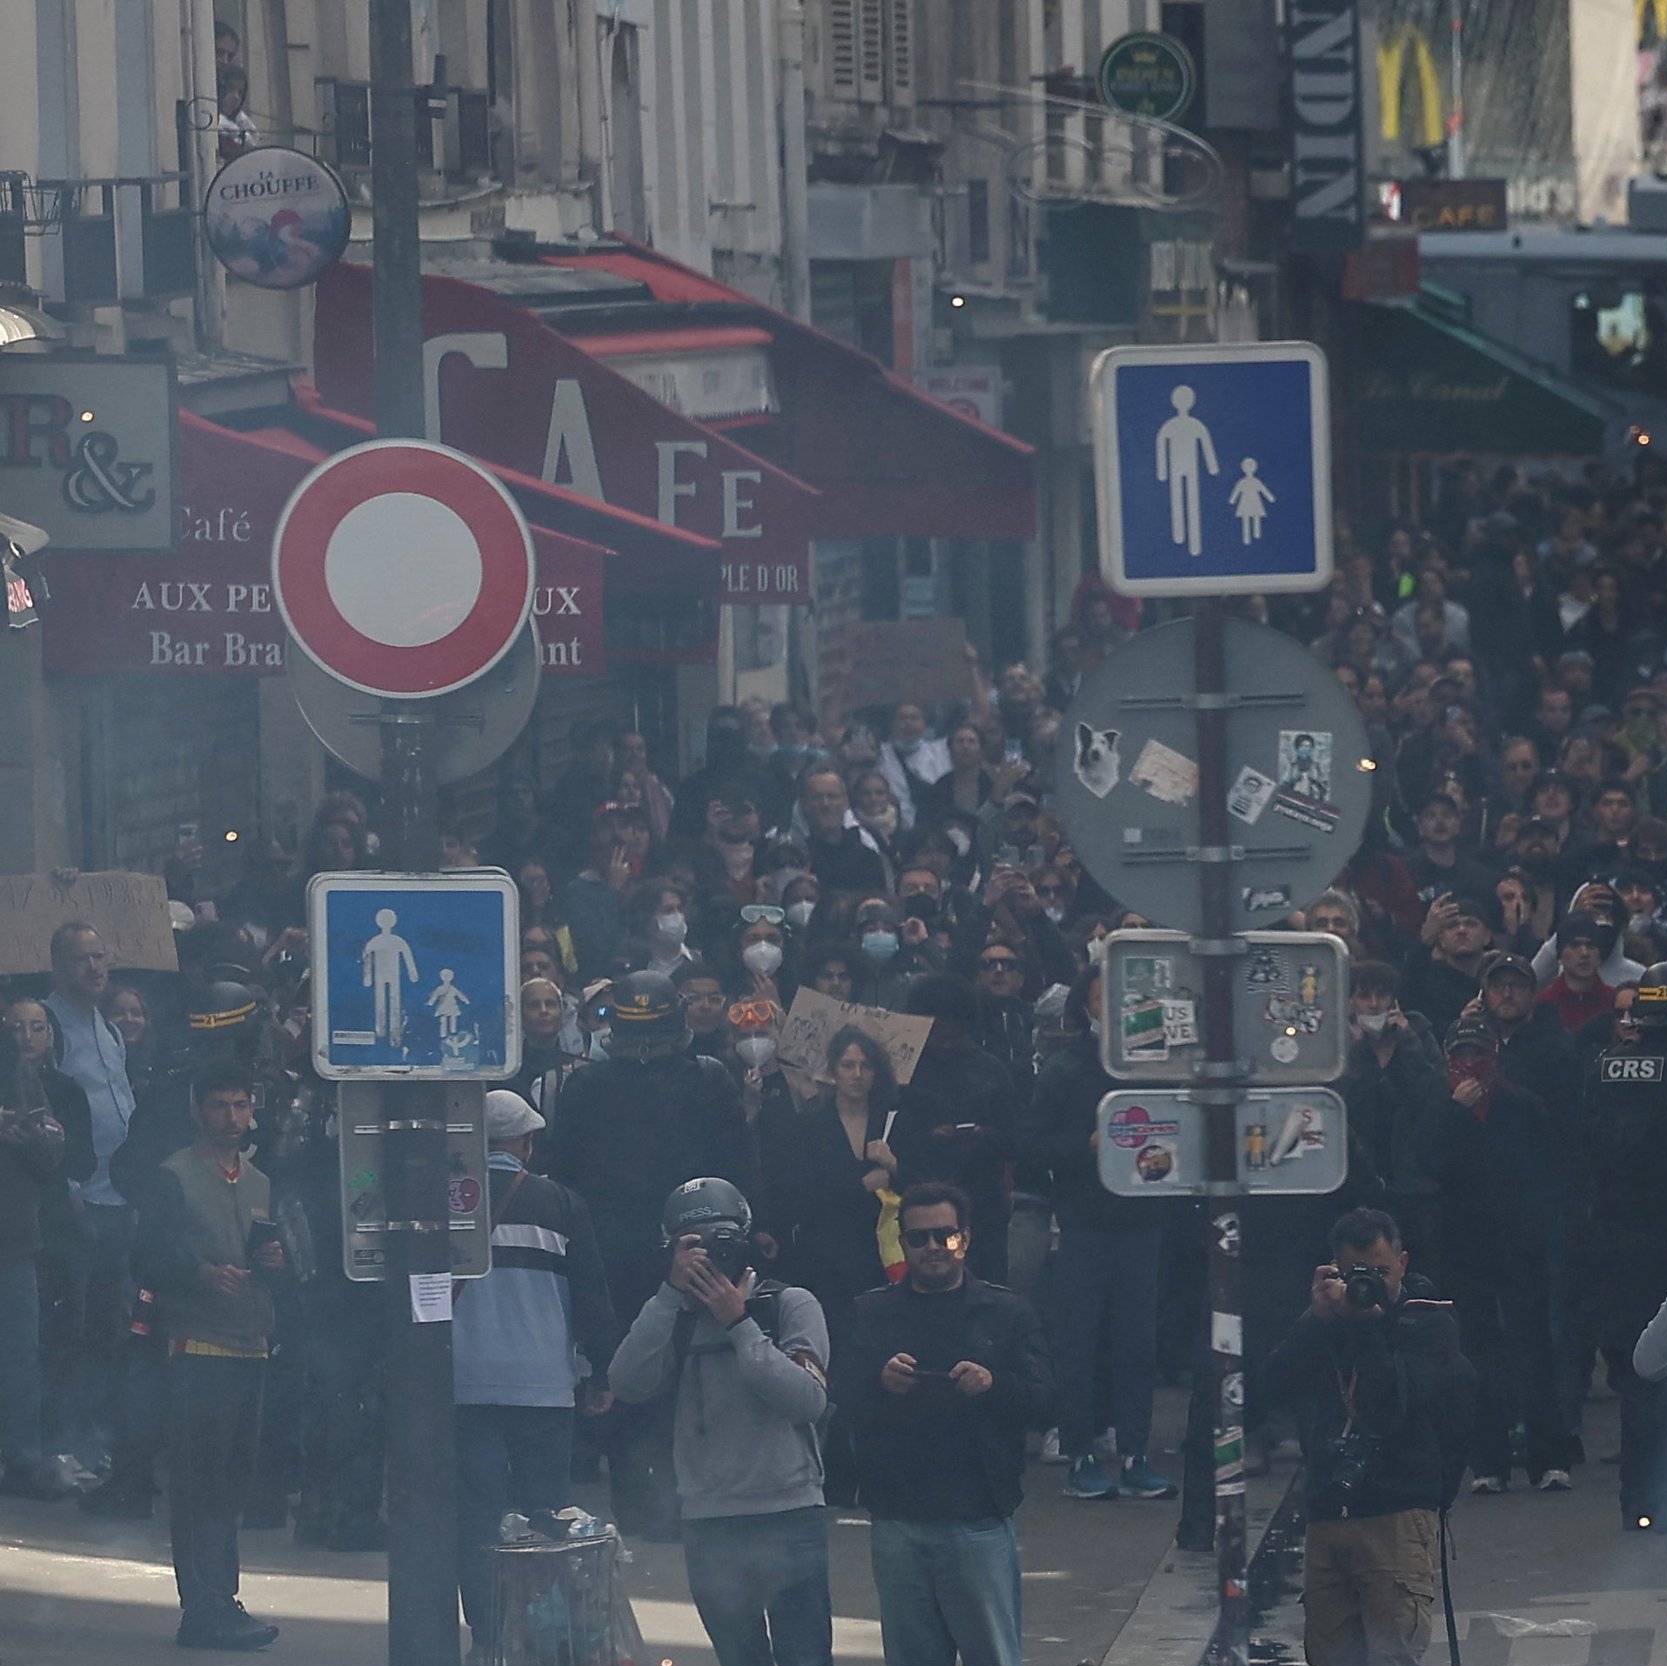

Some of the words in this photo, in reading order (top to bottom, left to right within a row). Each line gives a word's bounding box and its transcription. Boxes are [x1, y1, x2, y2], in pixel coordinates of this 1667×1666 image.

[1291, 0, 1357, 223] NDIN
[220, 175, 318, 201] CHOUFFE
[756, 564, 800, 594] D'OR
[131, 581, 213, 612] AUX
[225, 583, 272, 613] PE
[532, 586, 583, 617] UX
[149, 631, 209, 666] Bar
[223, 632, 284, 667] Bra
[538, 637, 582, 666] nt
[1606, 1059, 1656, 1079] CRS
